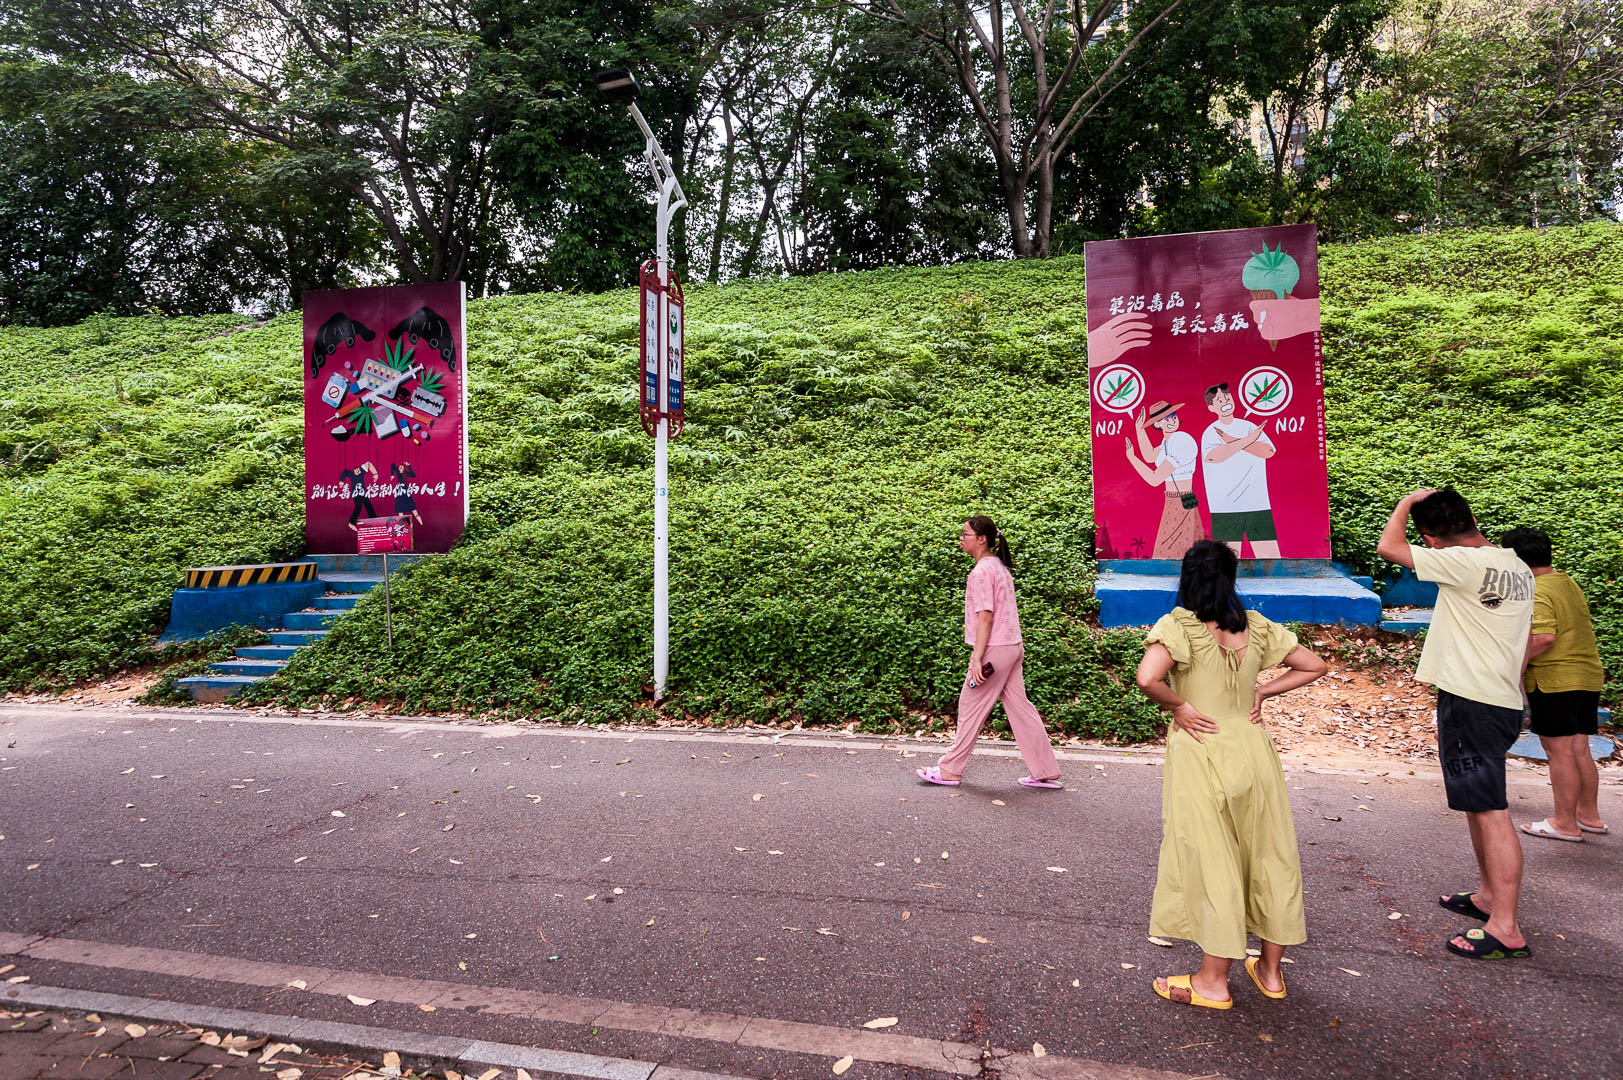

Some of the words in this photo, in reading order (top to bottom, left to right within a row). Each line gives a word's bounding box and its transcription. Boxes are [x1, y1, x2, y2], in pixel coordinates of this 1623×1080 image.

[1109, 291, 1201, 316] 莫沾毒品，
[1095, 419, 1124, 437] NO!
[1275, 415, 1306, 435] NO!
[311, 480, 461, 500] 别让毒品控制你的人生！
